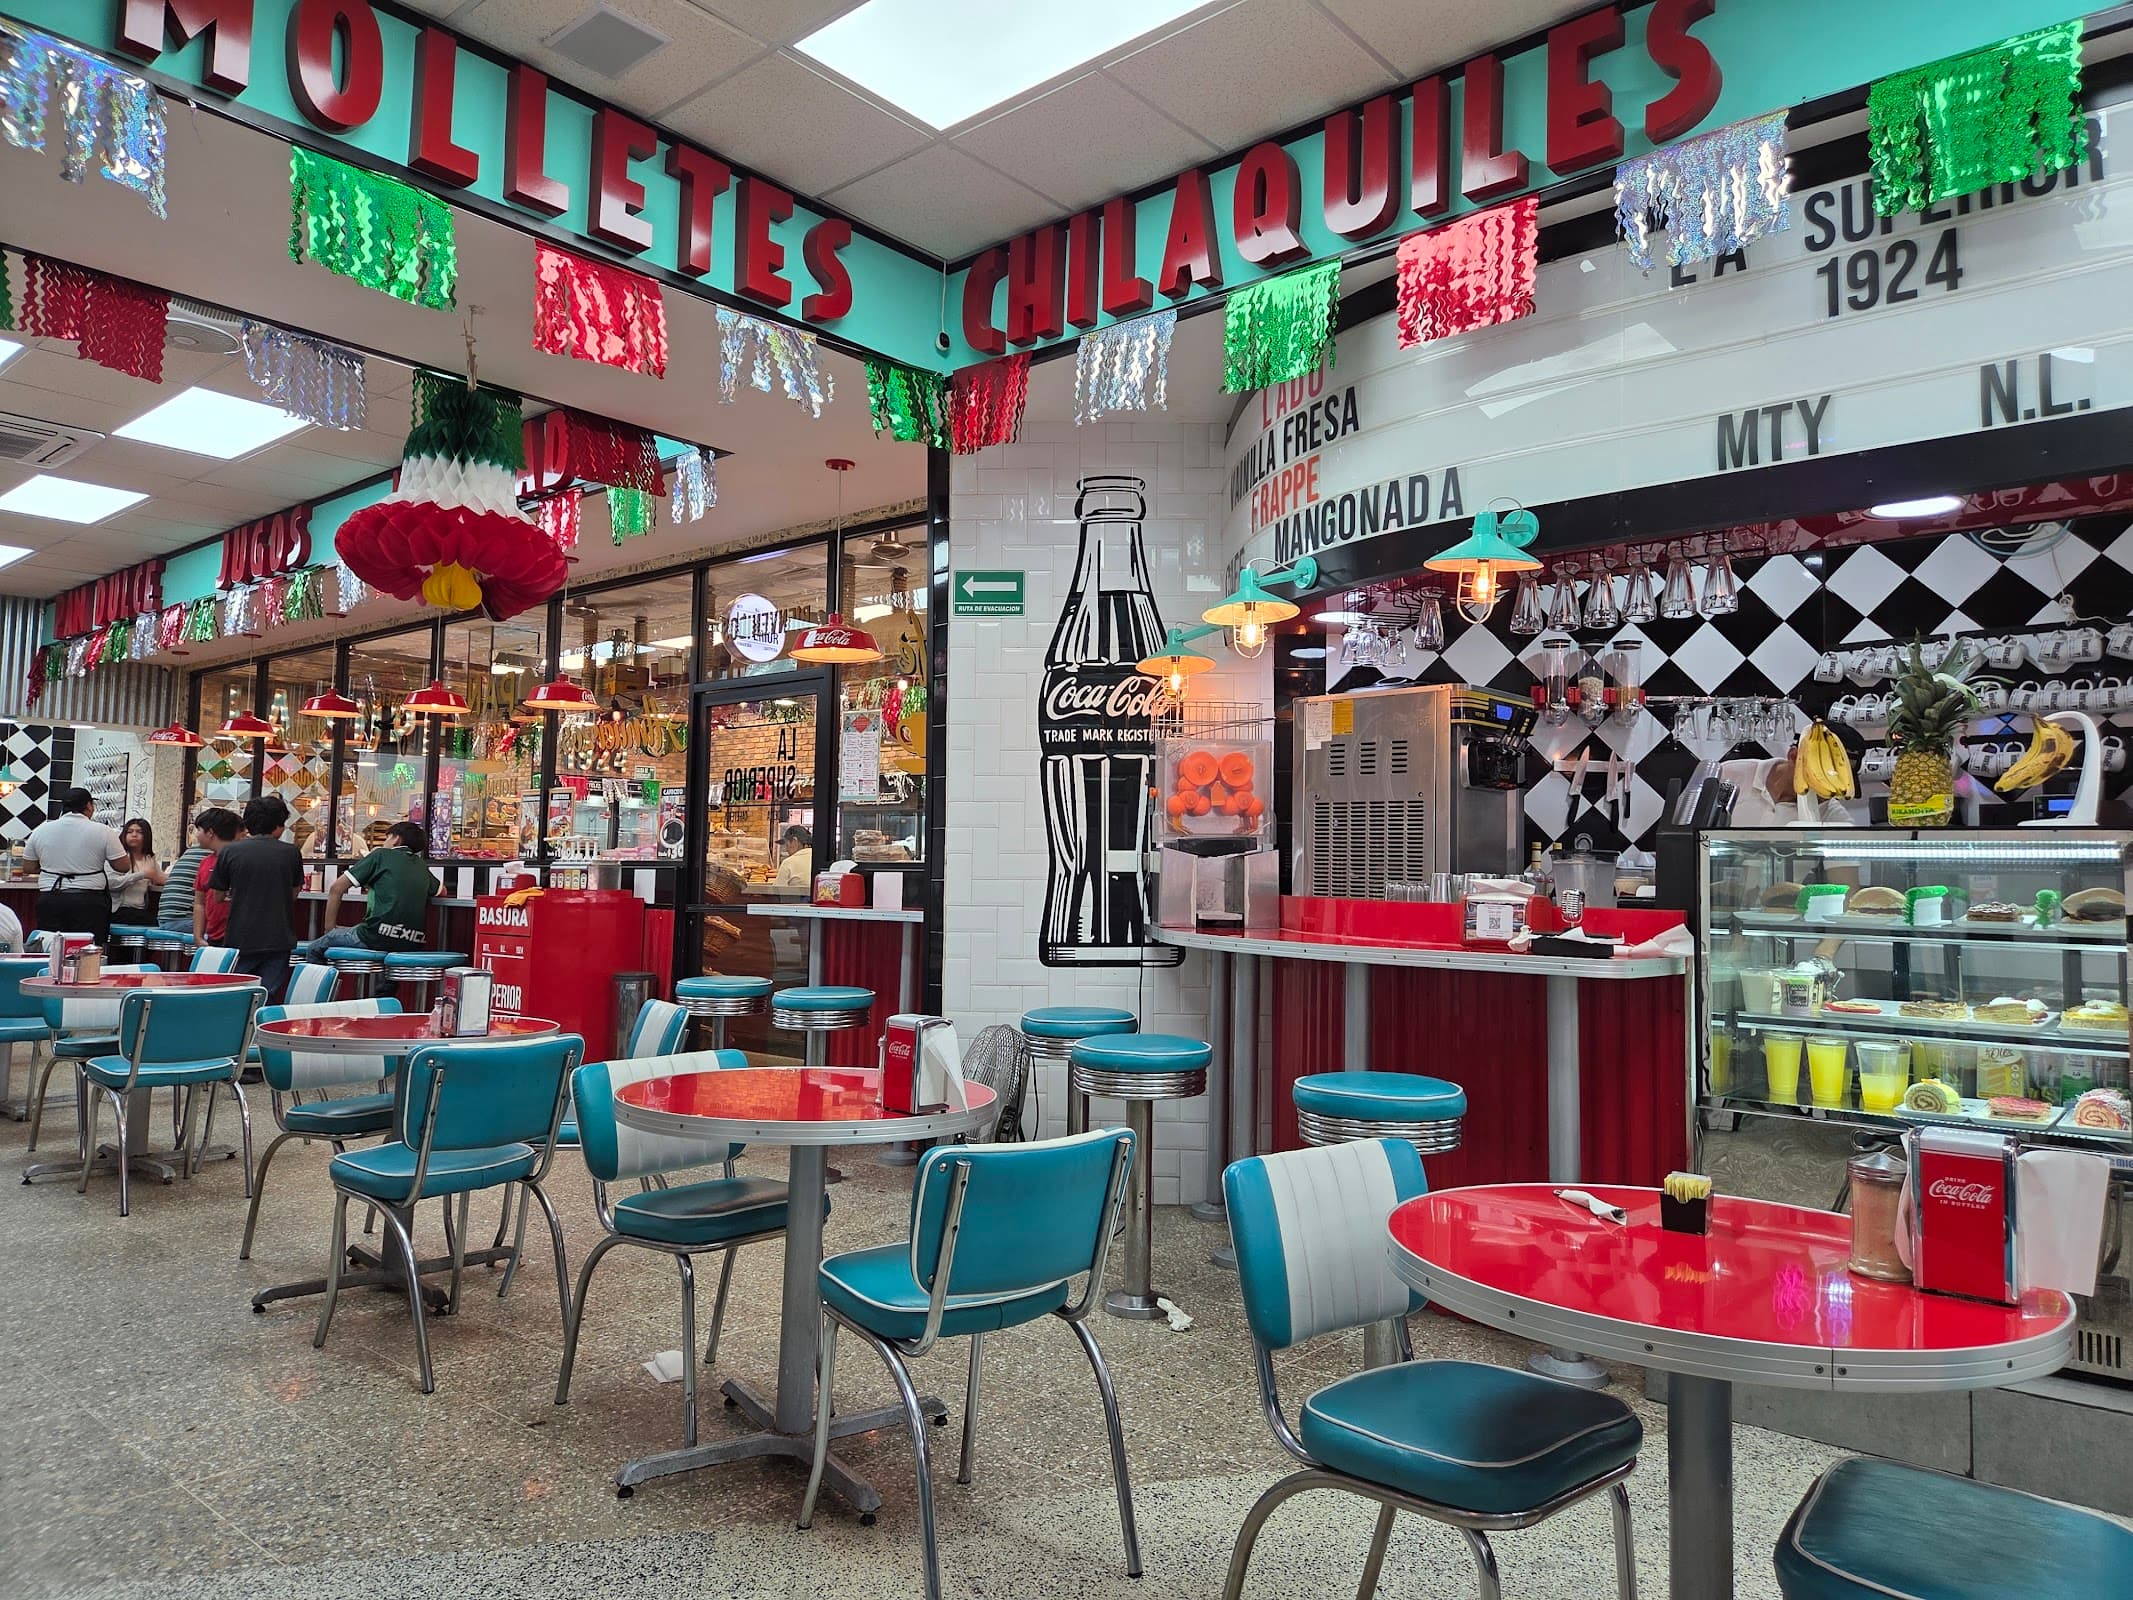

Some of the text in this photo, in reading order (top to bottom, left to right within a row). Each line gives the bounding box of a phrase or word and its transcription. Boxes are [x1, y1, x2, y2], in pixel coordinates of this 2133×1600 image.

[115, 0, 853, 323] MOLLETES
[963, 0, 1723, 355] CHILAQUILES
[1816, 227, 1963, 319] 1924
[1283, 386, 1360, 465] FRESA
[1716, 352, 2091, 471] MTY N.L.
[1251, 454, 1321, 535] FRAPPE
[215, 502, 312, 591] JUGOS
[93, 558, 166, 627] DULCE
[1045, 675, 1171, 721] Coca-Cola
[1043, 729, 1077, 743] TRADE
[1082, 729, 1114, 742] MARK
[479, 906, 528, 927] BASURA
[490, 983, 522, 1011] PERIOR
[1929, 1177, 1996, 1204] Coca-Cola
[1944, 1176, 1967, 1184] DRINK
[1951, 1201, 1986, 1210] BOTTLES
